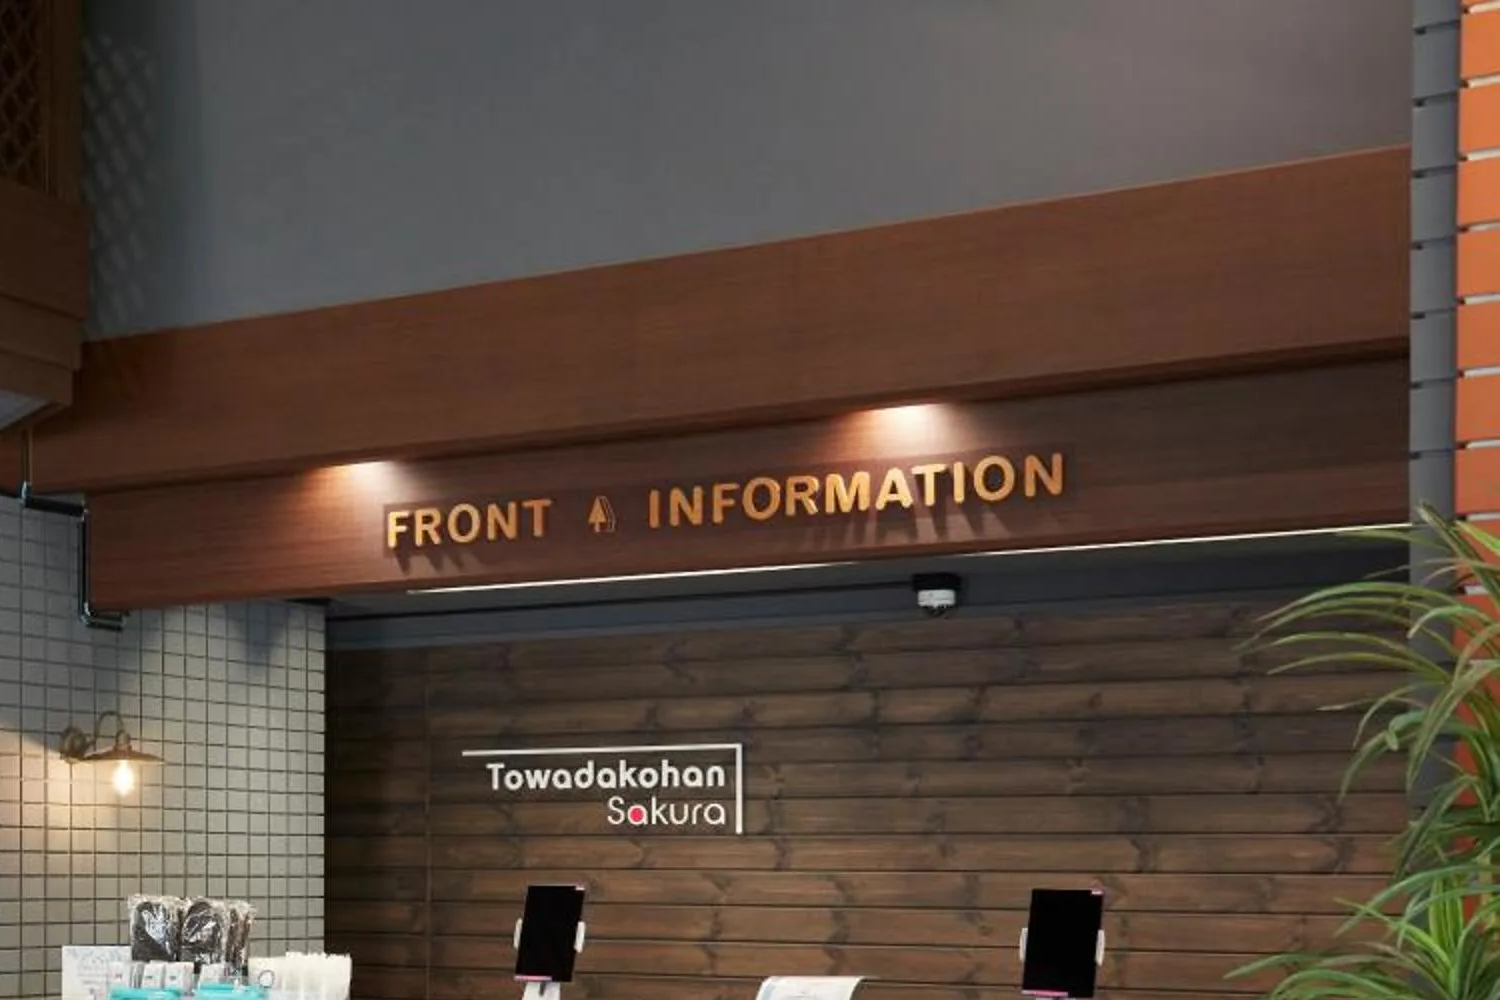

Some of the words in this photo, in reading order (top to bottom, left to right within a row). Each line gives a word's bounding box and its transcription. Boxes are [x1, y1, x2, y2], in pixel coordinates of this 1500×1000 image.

[387, 499, 551, 548] FRONT
[648, 453, 1064, 528] INFORMATION
[486, 760, 725, 790] Towadakohan
[607, 796, 725, 825] Sakura
